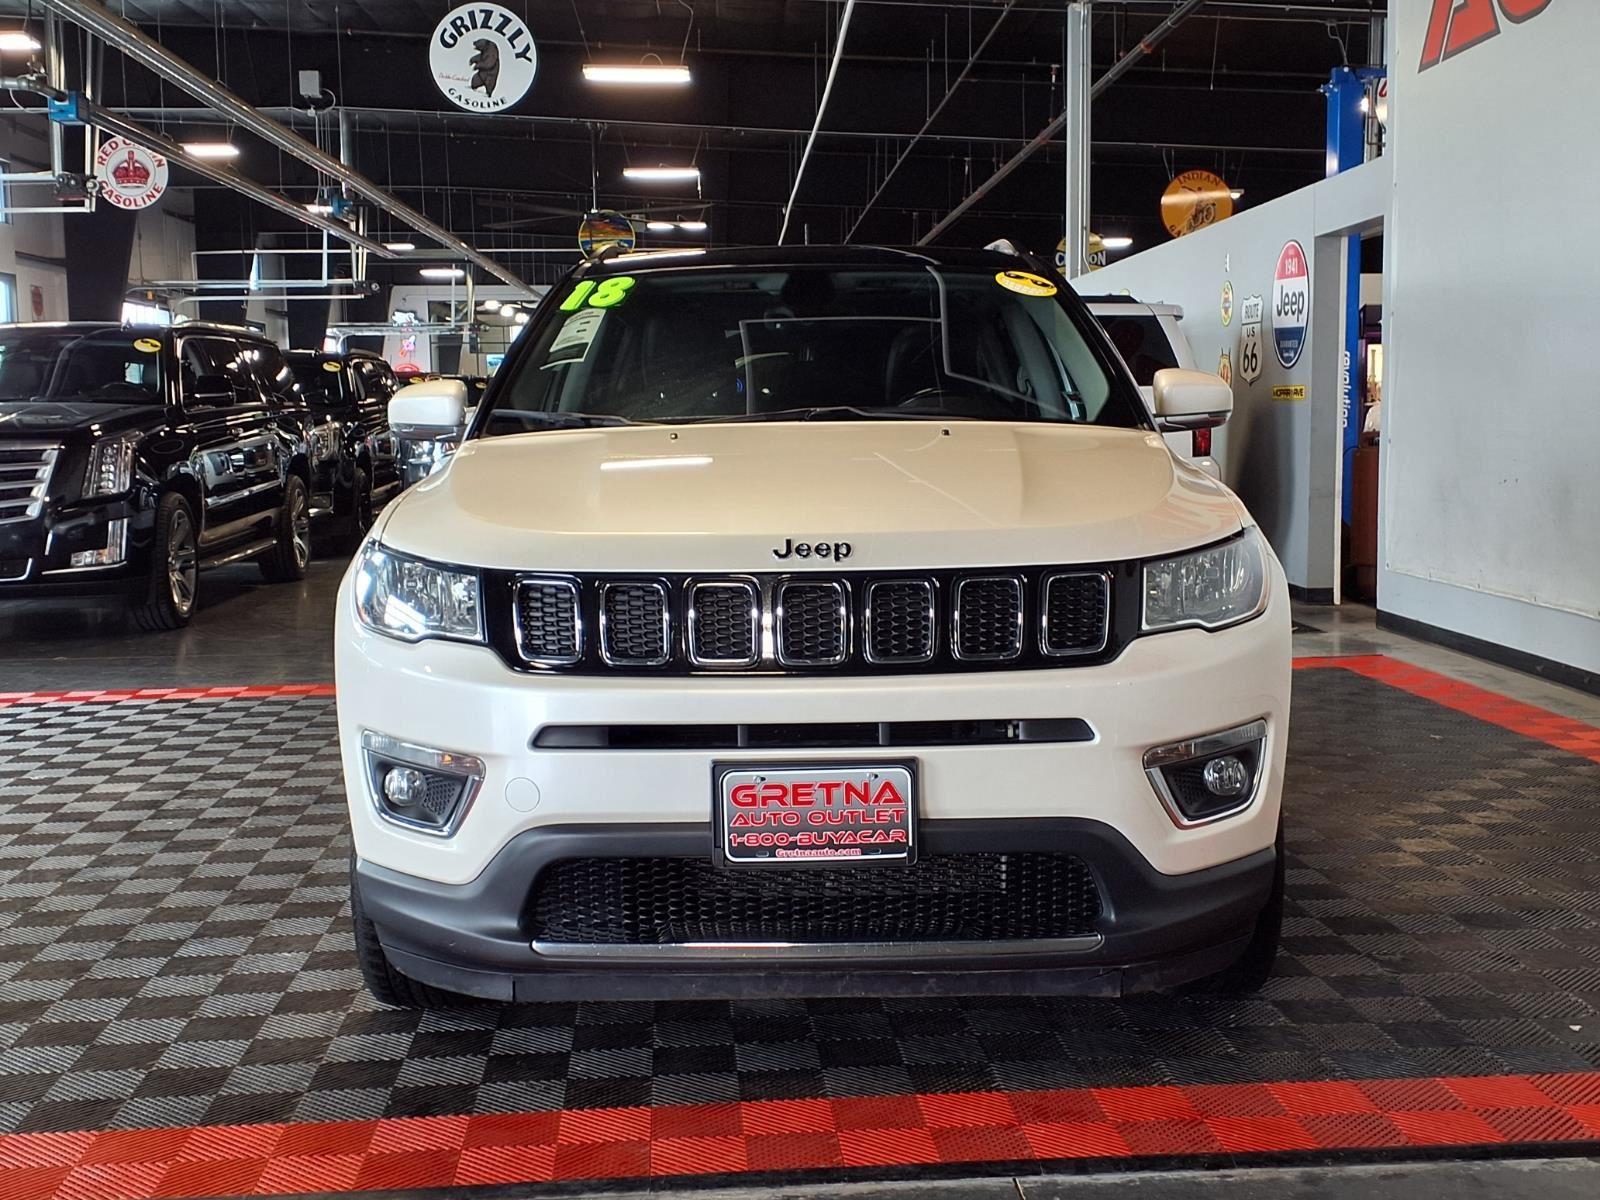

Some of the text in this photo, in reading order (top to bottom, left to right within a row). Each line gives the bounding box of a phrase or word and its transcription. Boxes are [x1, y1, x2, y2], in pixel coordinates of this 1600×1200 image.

[440, 9, 532, 63] GRIZZLY
[448, 87, 507, 109] GASOLINE
[97, 140, 119, 166] RED
[1177, 172, 1219, 186] INDIAN
[100, 180, 163, 208] GASOLINE
[1285, 257, 1299, 275] 1941
[560, 276, 635, 311] 18
[1276, 285, 1305, 323] Jeep
[1245, 303, 1260, 319] ROUTE
[1246, 326, 1256, 338] US
[1242, 342, 1258, 373] 66
[772, 538, 852, 562] Jeep
[729, 779, 905, 809] GRETNA
[730, 808, 907, 827] AUTO OUTLET
[729, 829, 906, 847] 1-800-BUYACAR
[775, 847, 862, 858] Gretnaauto.com
